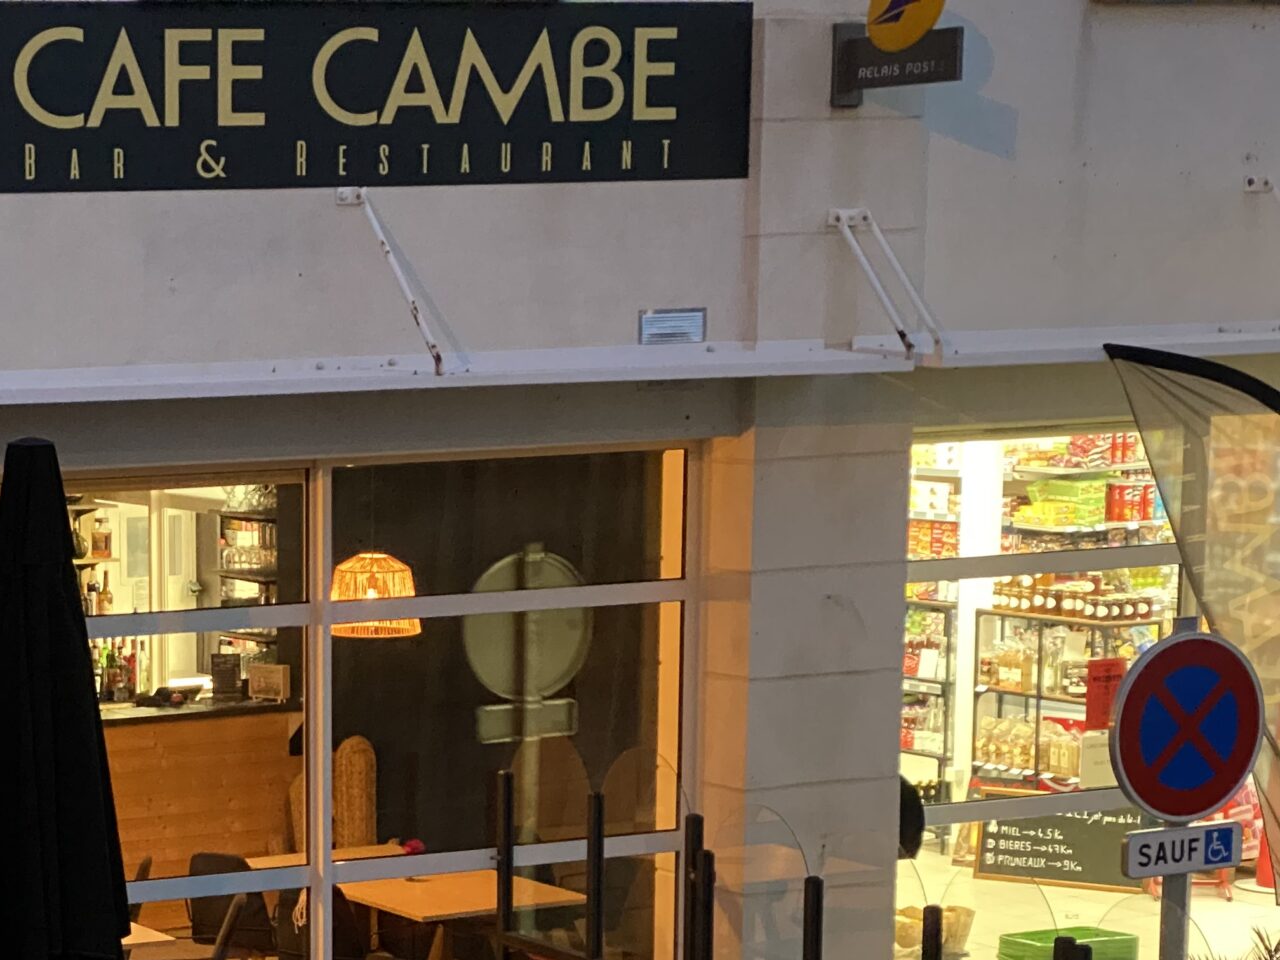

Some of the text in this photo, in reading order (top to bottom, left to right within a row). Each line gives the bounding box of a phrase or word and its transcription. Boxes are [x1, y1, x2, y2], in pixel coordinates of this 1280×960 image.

[13, 26, 678, 129] CAFE CAMBE
[858, 60, 951, 79] RELAIS POST
[25, 139, 670, 180] BAR & RESTAURANT
[1000, 825, 1022, 837] MIEL
[999, 839, 1032, 852] BIERES
[1138, 837, 1201, 868] SAUF
[997, 854, 1047, 869] PRUNEAUX
